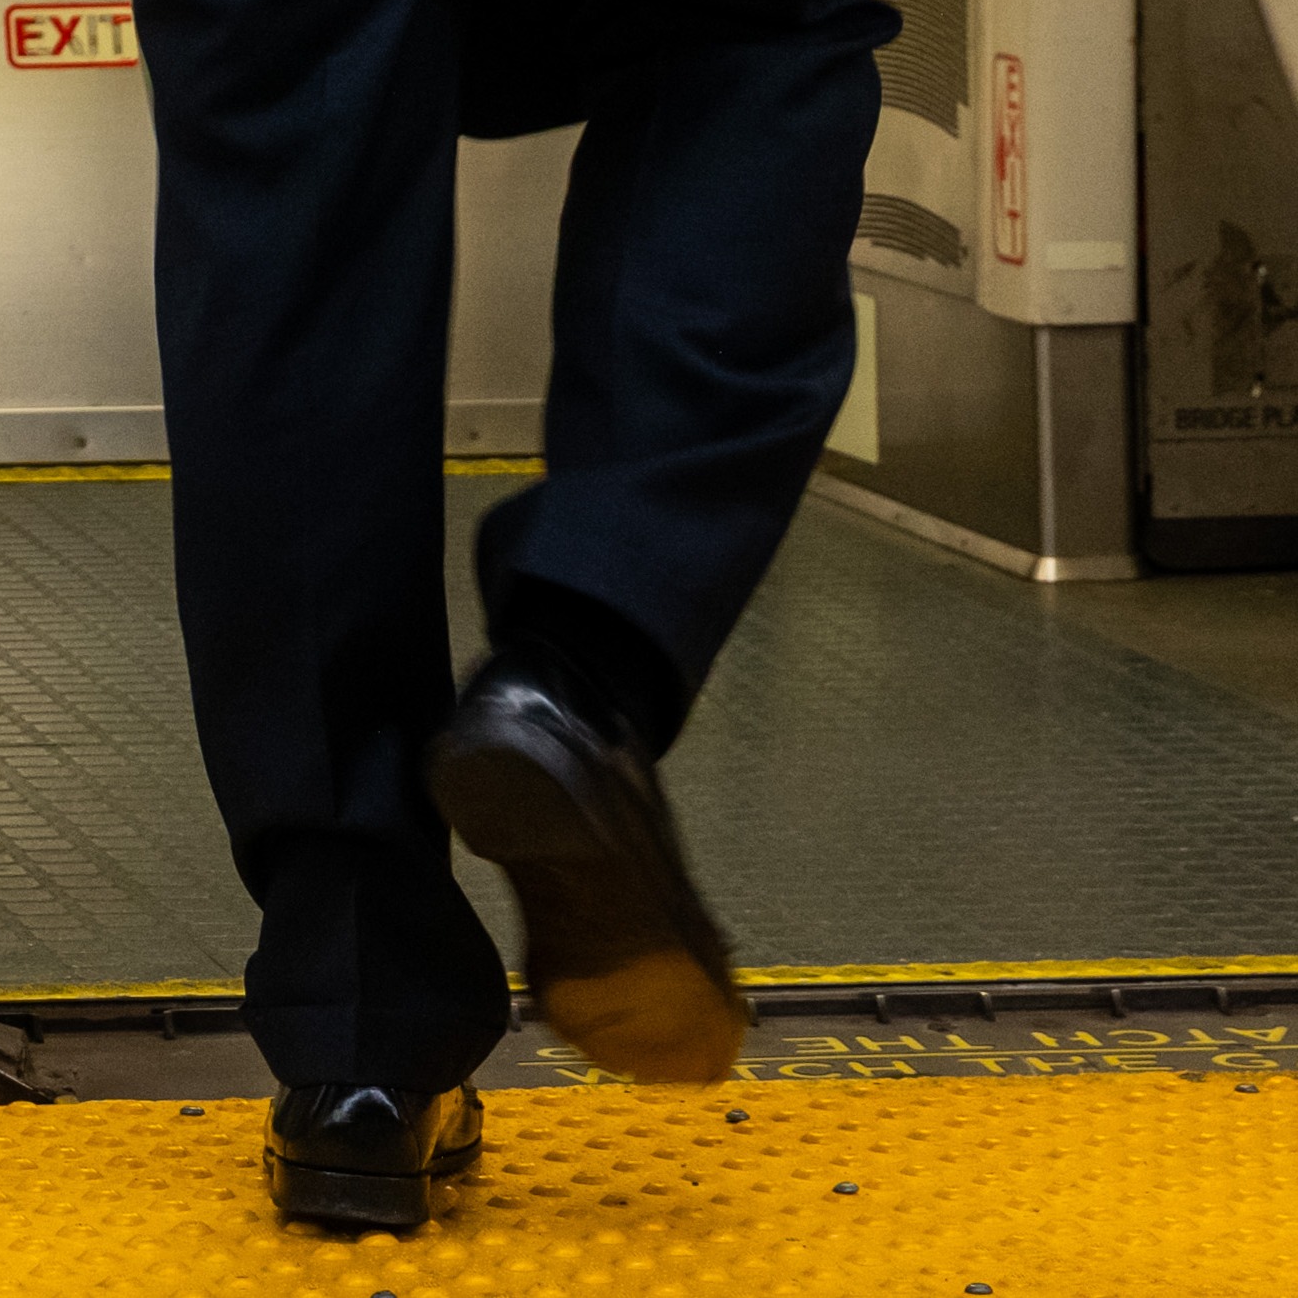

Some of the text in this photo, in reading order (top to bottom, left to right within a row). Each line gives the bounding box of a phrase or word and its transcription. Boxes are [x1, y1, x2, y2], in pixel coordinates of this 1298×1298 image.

[15, 14, 133, 57] EXIT
[1174, 407, 1253, 429] BRIDGE
[957, 1053, 1174, 1074] THE
